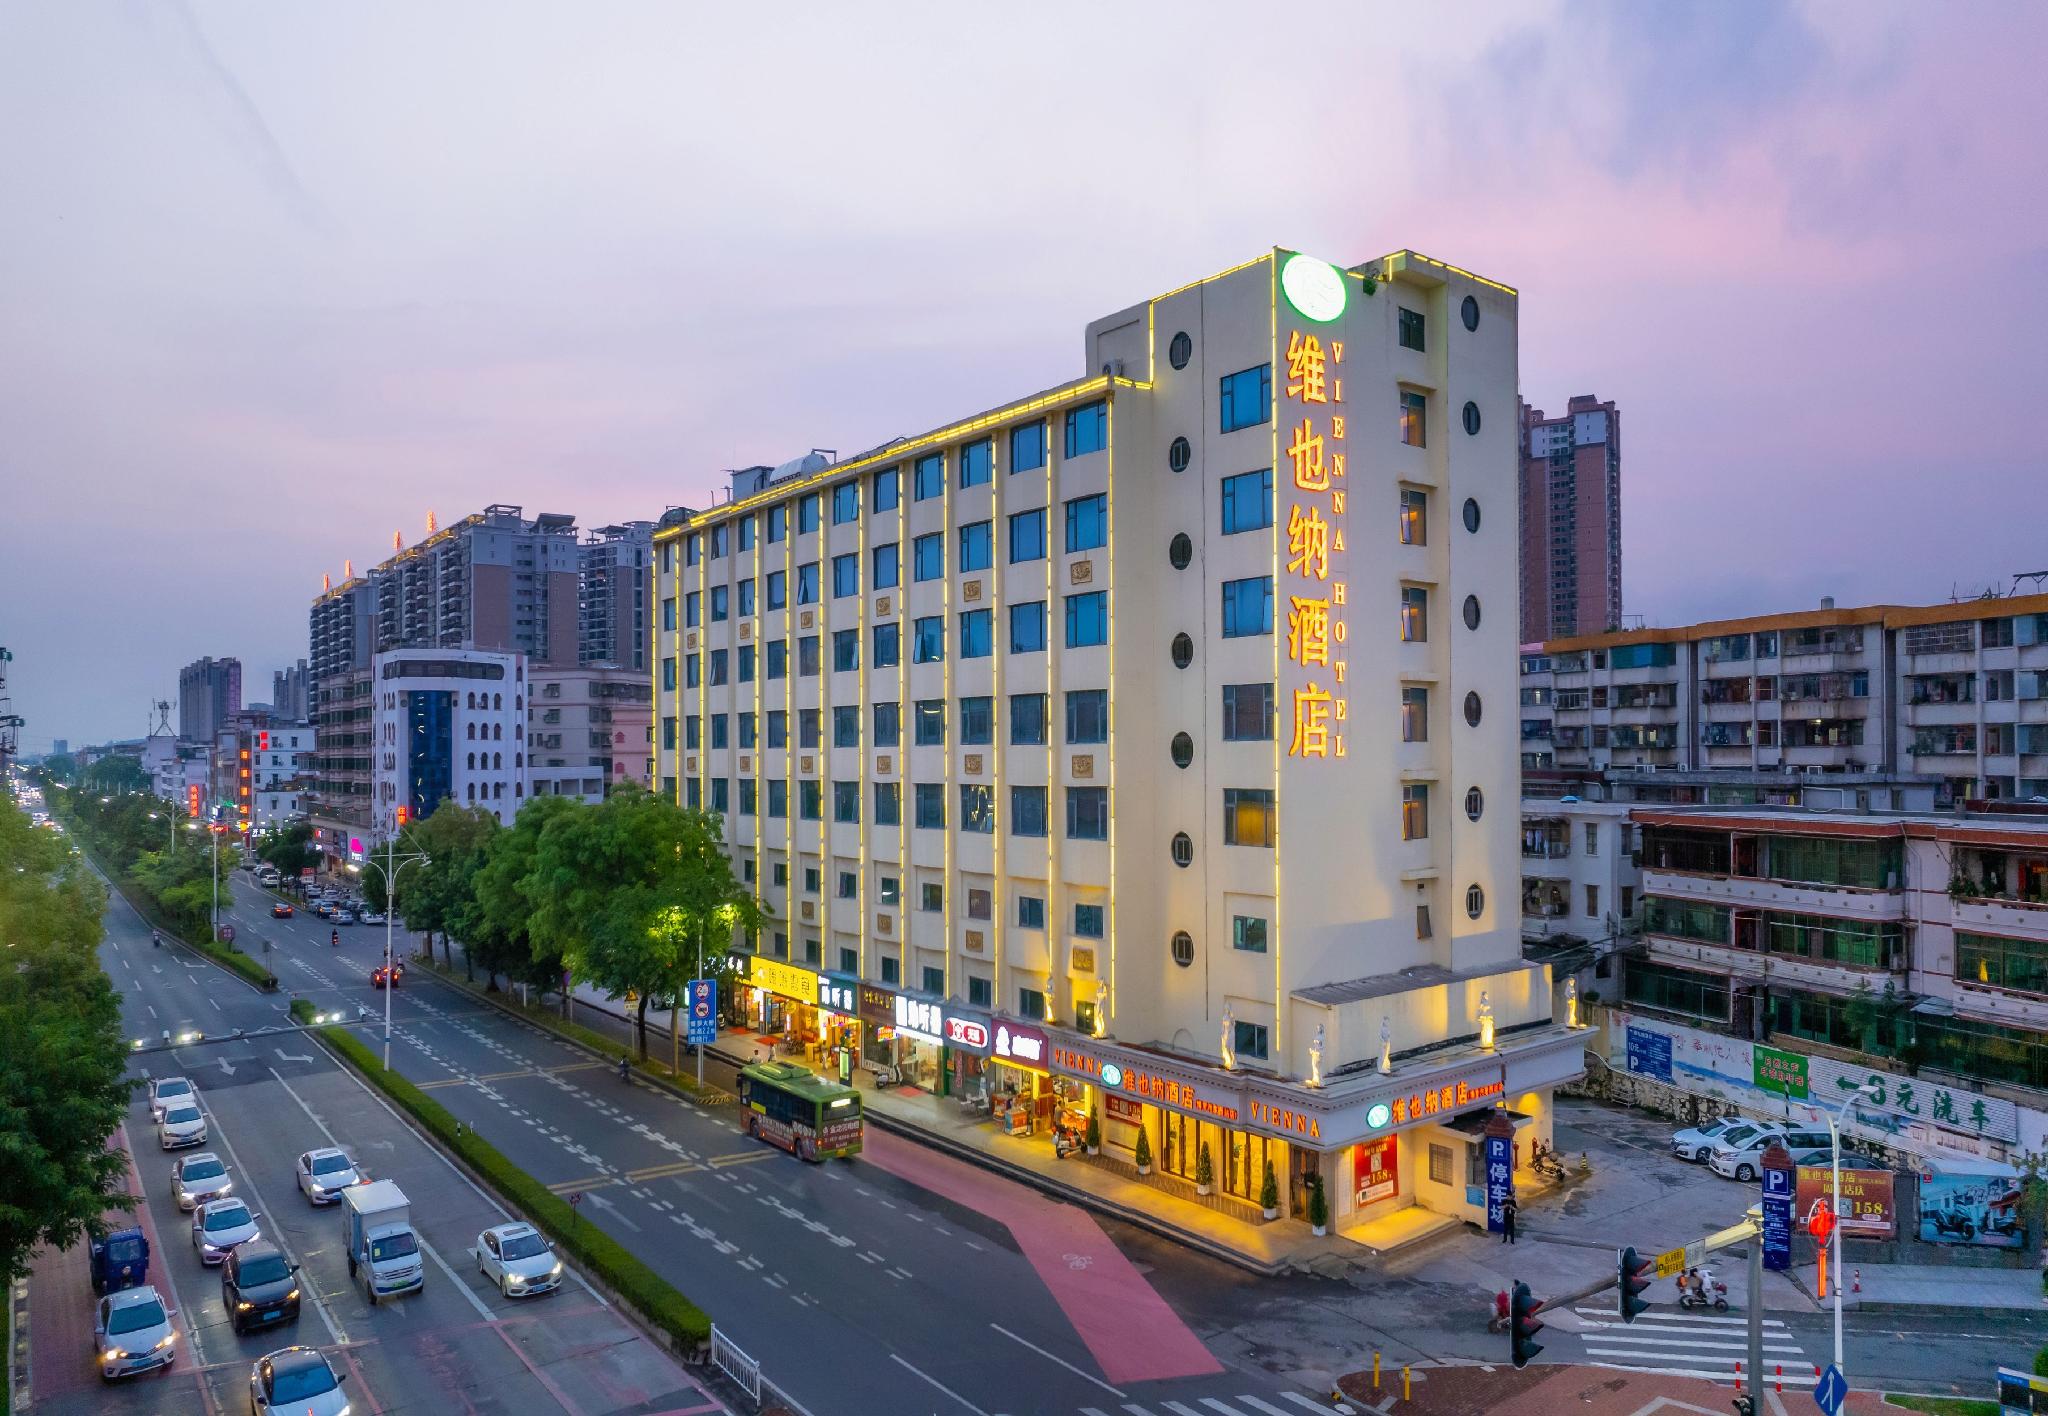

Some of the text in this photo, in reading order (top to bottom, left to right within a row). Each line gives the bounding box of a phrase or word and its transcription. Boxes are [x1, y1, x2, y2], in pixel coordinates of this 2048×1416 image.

[1286, 330, 1331, 758] 维也纳酒店
[1331, 341, 1346, 758] VIENNA HOTEL
[1055, 1047, 1102, 1077] VIENNA
[1630, 1055, 1639, 1069] P
[1122, 1067, 1195, 1110] 维也纳酒店
[1391, 1080, 1468, 1125] 维也纳酒店
[1250, 1099, 1321, 1138] VIENNA
[1371, 1169, 1388, 1184] 158
[1489, 1162, 1508, 1224] 停车场
[1769, 1170, 1784, 1190] P
[1854, 1201, 1884, 1215] 158
